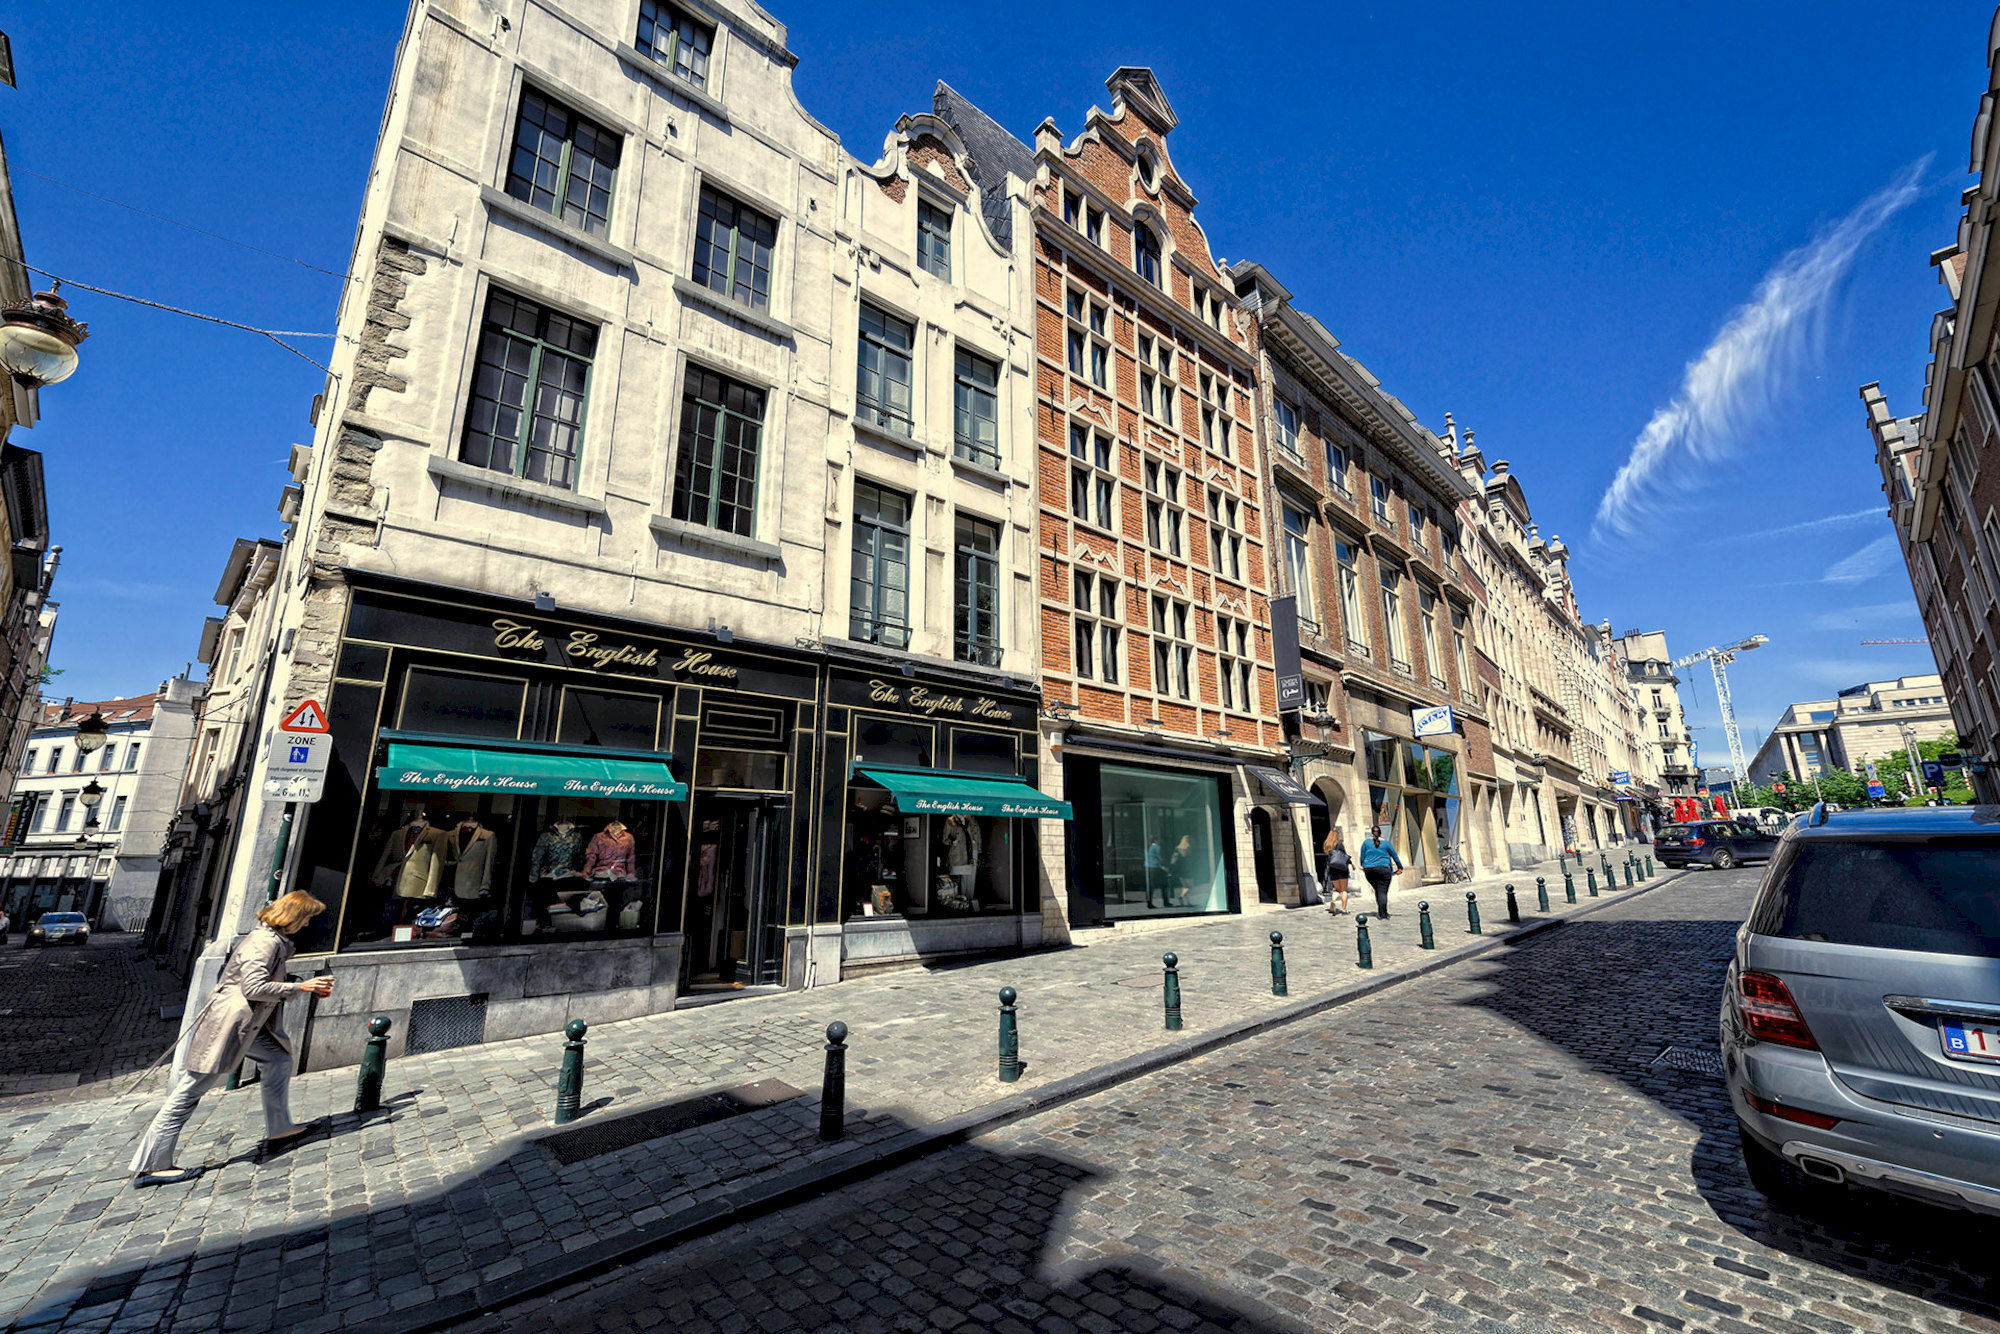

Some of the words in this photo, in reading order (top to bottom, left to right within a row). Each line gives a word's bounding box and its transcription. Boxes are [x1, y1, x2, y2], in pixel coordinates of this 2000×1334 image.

[492, 618, 546, 651] The
[565, 631, 659, 668] English
[672, 648, 738, 679] House
[869, 679, 900, 704] The
[909, 686, 964, 715] English
[971, 696, 1013, 721] House
[287, 736, 316, 745] ZONE
[1923, 764, 1939, 779] P
[400, 771, 430, 785] The
[432, 773, 490, 789] English
[492, 776, 538, 789] House
[282, 788, 288, 797] 6
[563, 779, 588, 792] The
[590, 781, 637, 796] English
[638, 783, 675, 796] House
[916, 799, 931, 809] The
[931, 800, 960, 812] English
[961, 803, 984, 812] House
[1001, 804, 1014, 813] The
[1015, 804, 1039, 816] English
[1039, 806, 1059, 815] House
[1951, 1037, 1965, 1050] B
